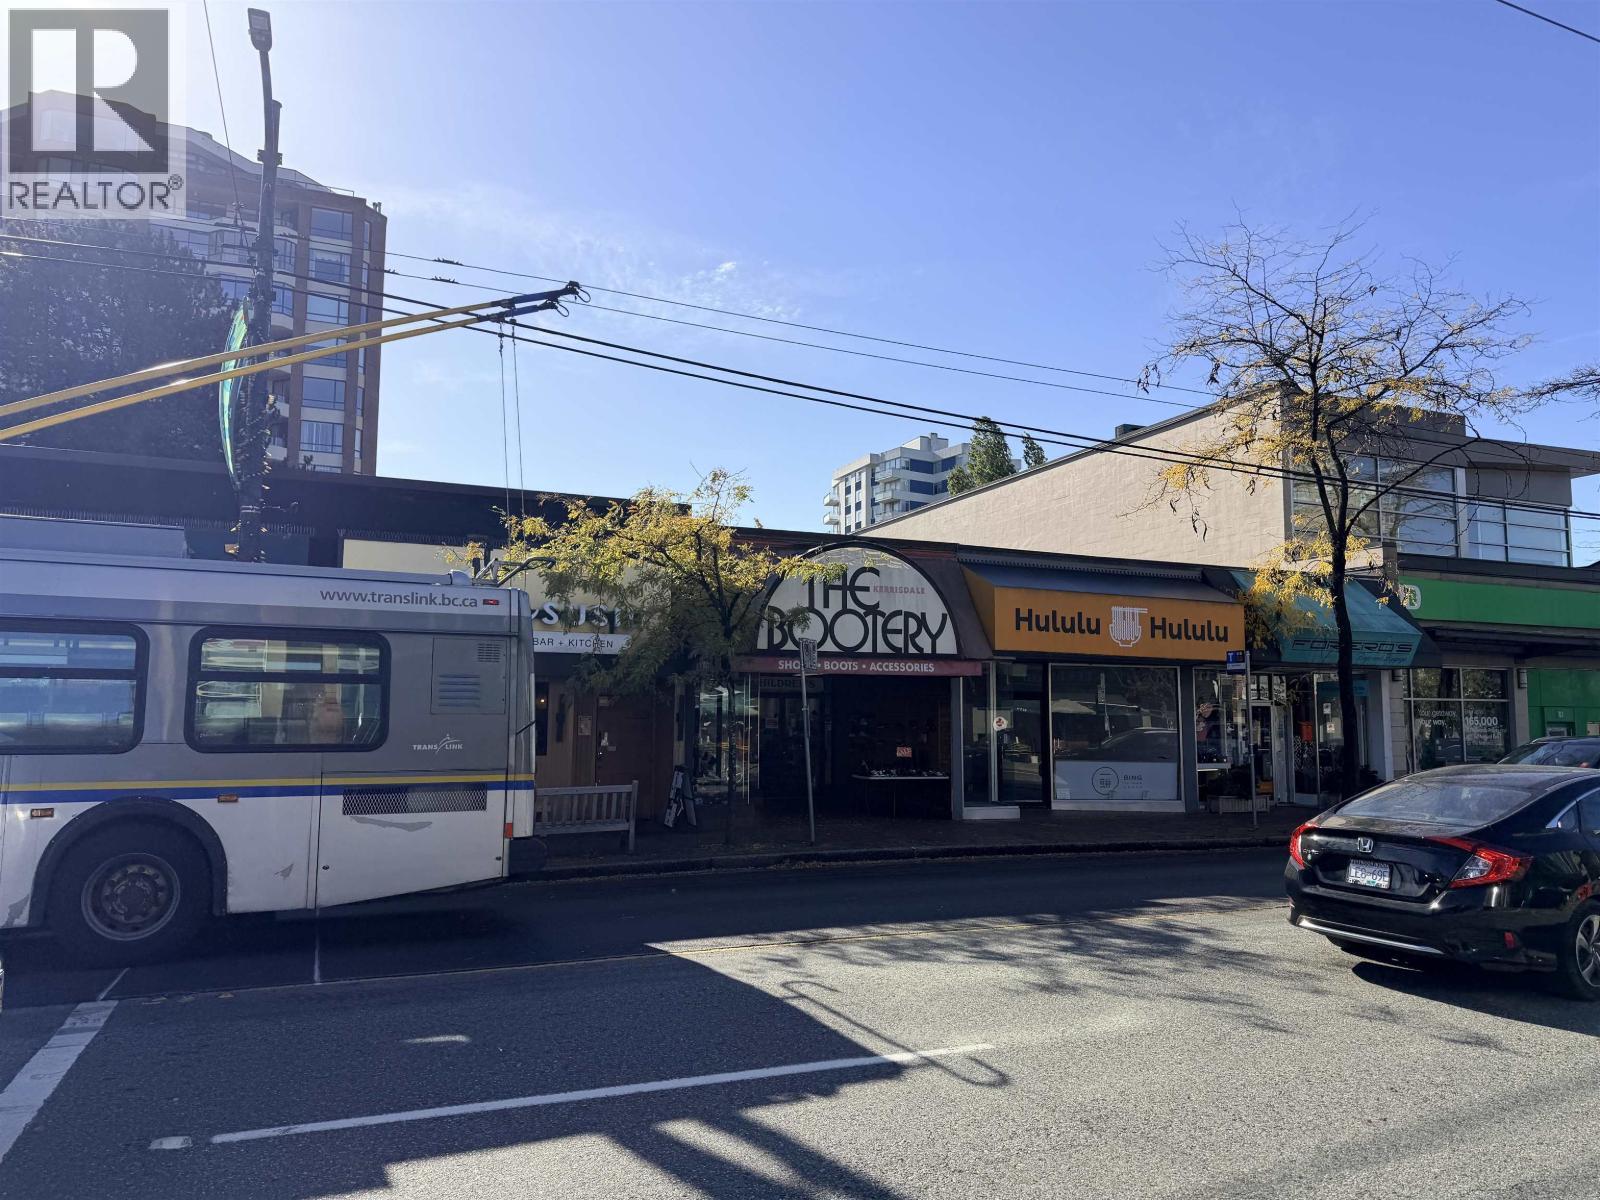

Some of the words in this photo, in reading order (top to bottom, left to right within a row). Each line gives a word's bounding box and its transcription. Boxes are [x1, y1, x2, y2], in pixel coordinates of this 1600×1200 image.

[806, 566, 880, 610] THE
[873, 584, 926, 595] KERRISDALE
[320, 590, 478, 608] www.translink.bc.ca
[768, 606, 948, 654] BOOTERY
[1015, 608, 1101, 636] Hululu
[1150, 617, 1229, 643] Hululu
[533, 638, 554, 647] BAR
[568, 638, 613, 648] KITCHEN
[778, 660, 811, 670] SHO
[824, 661, 858, 671] BOOTS
[869, 661, 935, 673] ACCESSORIES
[1465, 716, 1498, 727] 165,000
